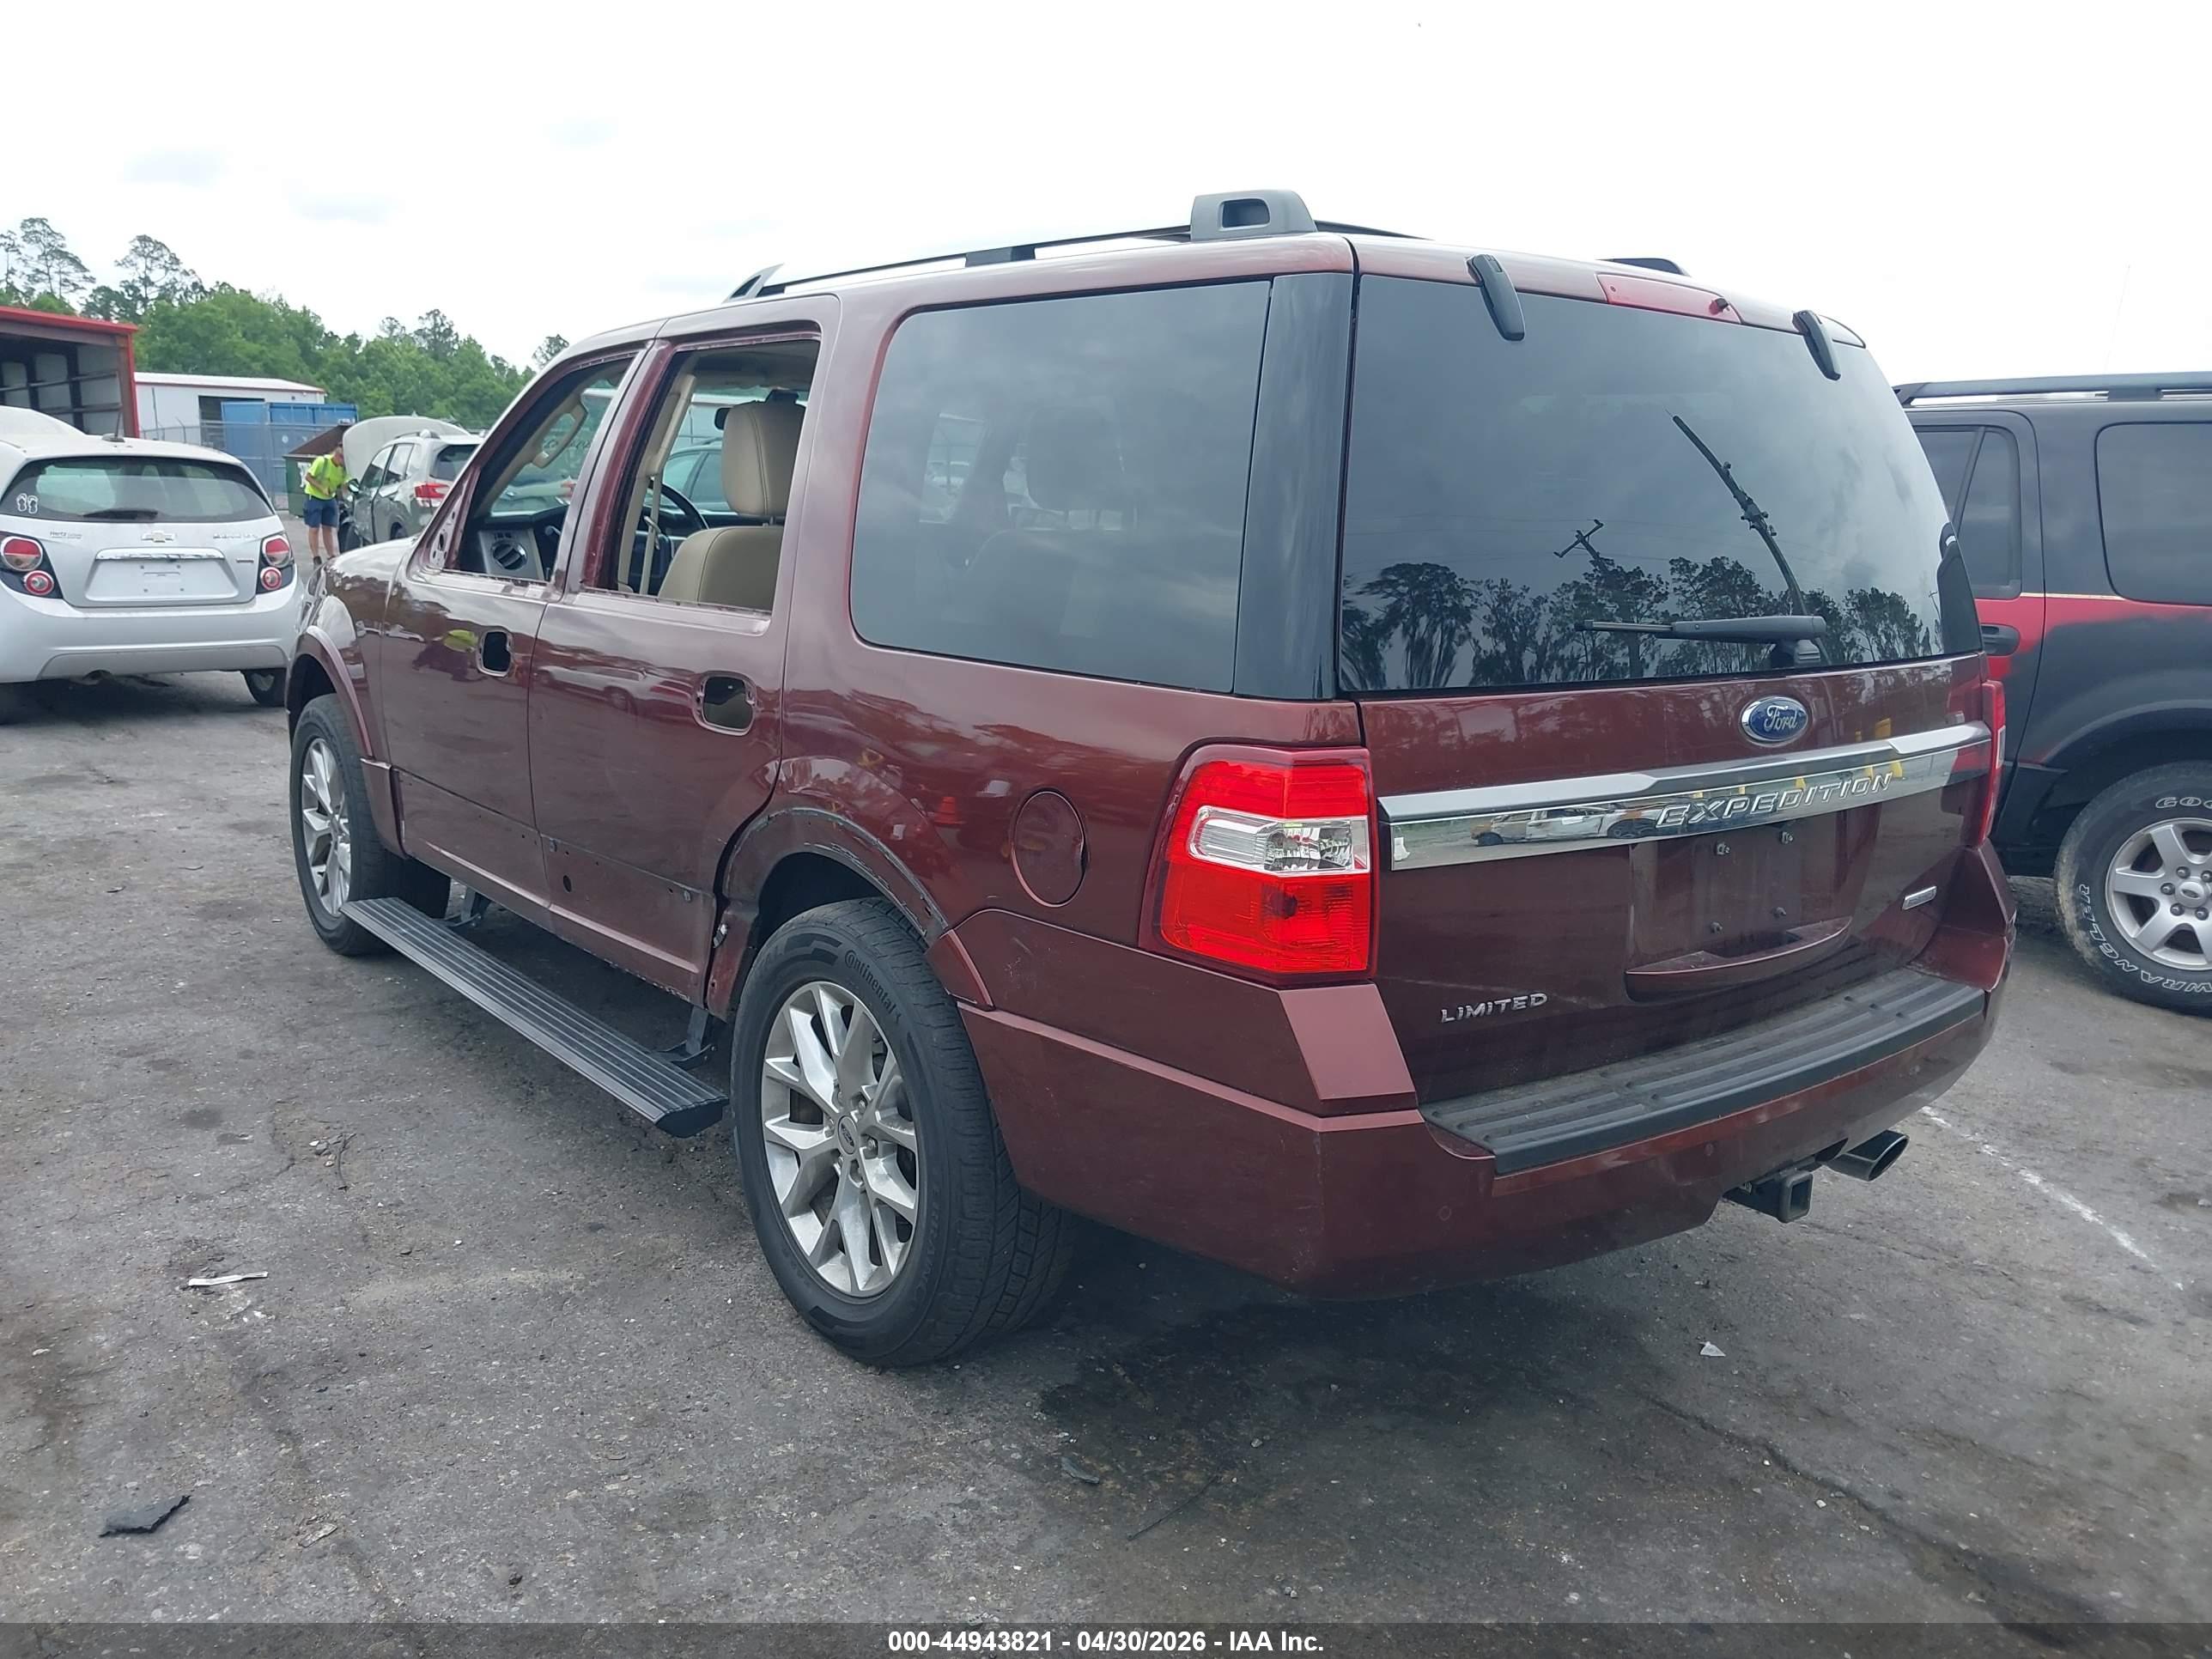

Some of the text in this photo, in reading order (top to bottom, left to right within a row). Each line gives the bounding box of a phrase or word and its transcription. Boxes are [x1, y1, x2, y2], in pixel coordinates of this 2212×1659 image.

[1763, 705, 1798, 732] Ford
[1656, 772, 1893, 828] EXPEDITION
[844, 949, 896, 1014] Continental
[1441, 993, 1547, 1023] LIMITED
